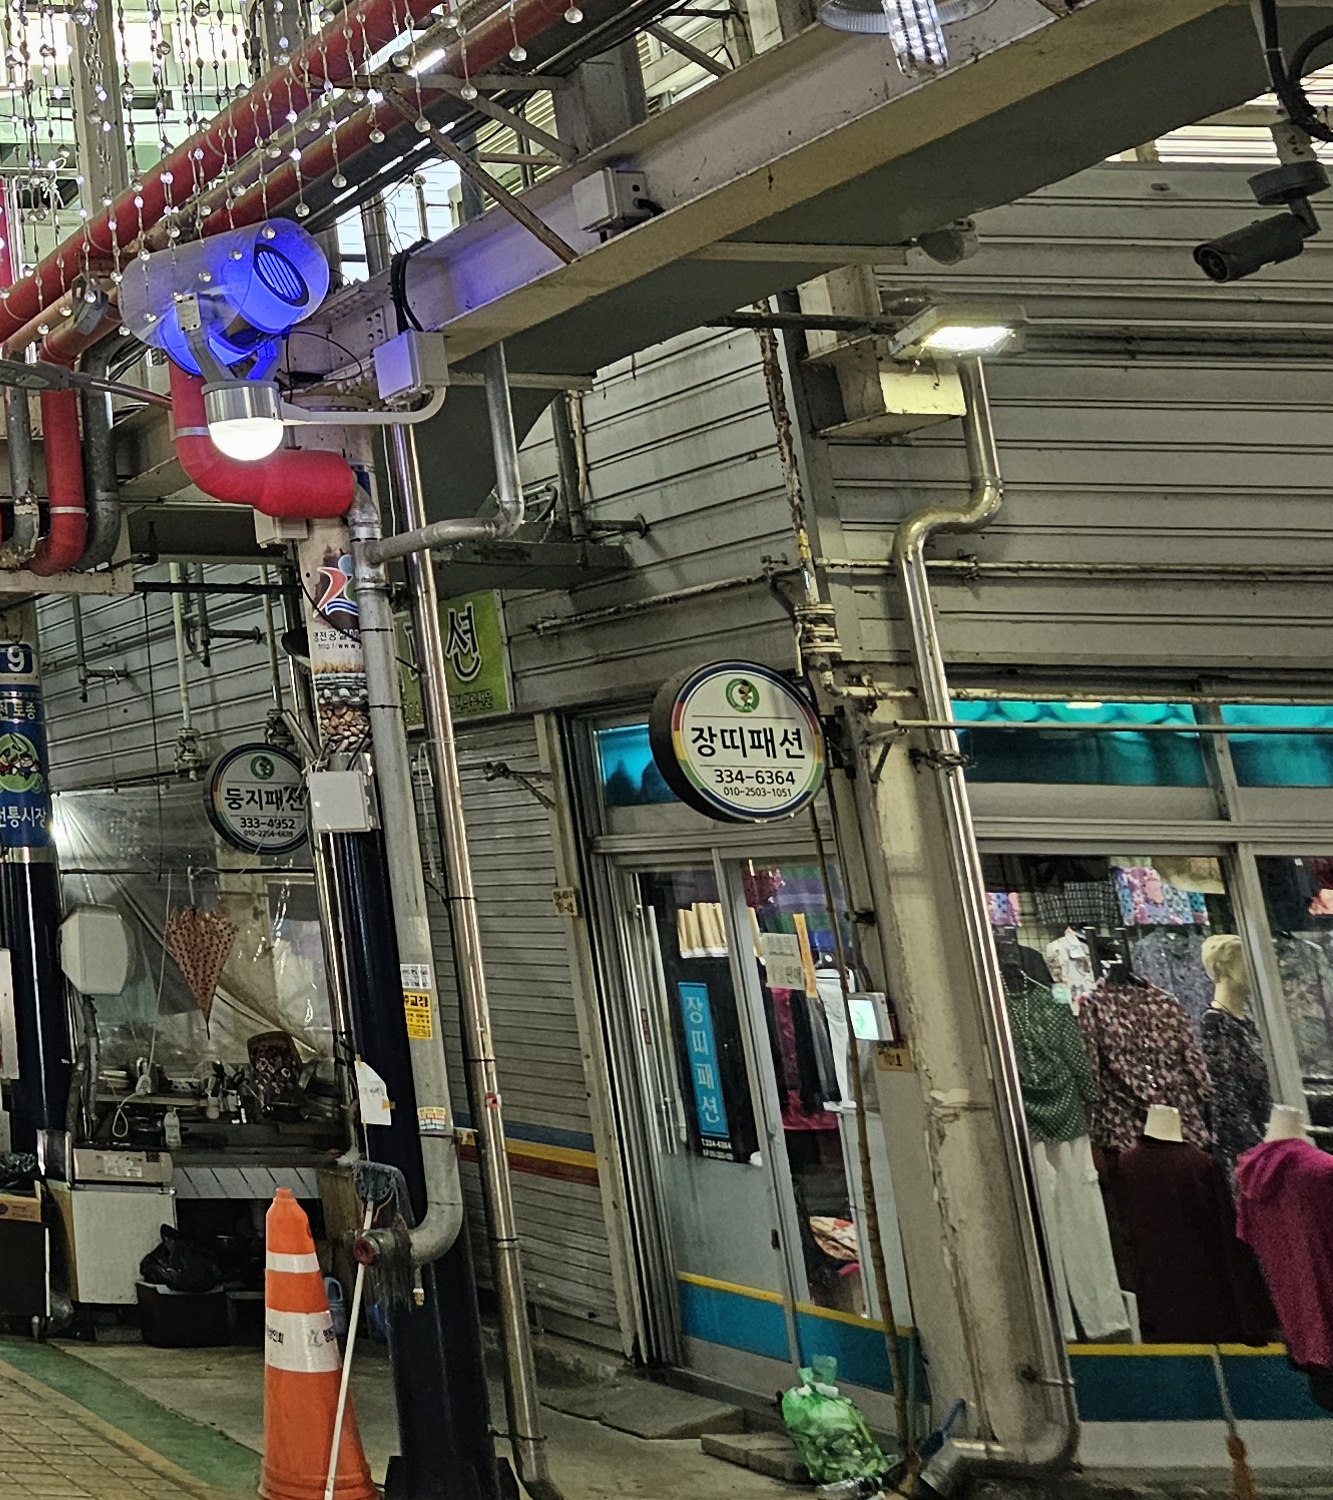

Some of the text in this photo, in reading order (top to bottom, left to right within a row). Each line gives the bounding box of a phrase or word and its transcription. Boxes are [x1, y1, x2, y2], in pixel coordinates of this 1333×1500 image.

[7, 645, 25, 672] 9
[691, 726, 805, 759] 장띠패션
[714, 769, 795, 785] 334-6364
[225, 787, 305, 811] 둥지패션
[723, 786, 792, 797] 010-2503-1051
